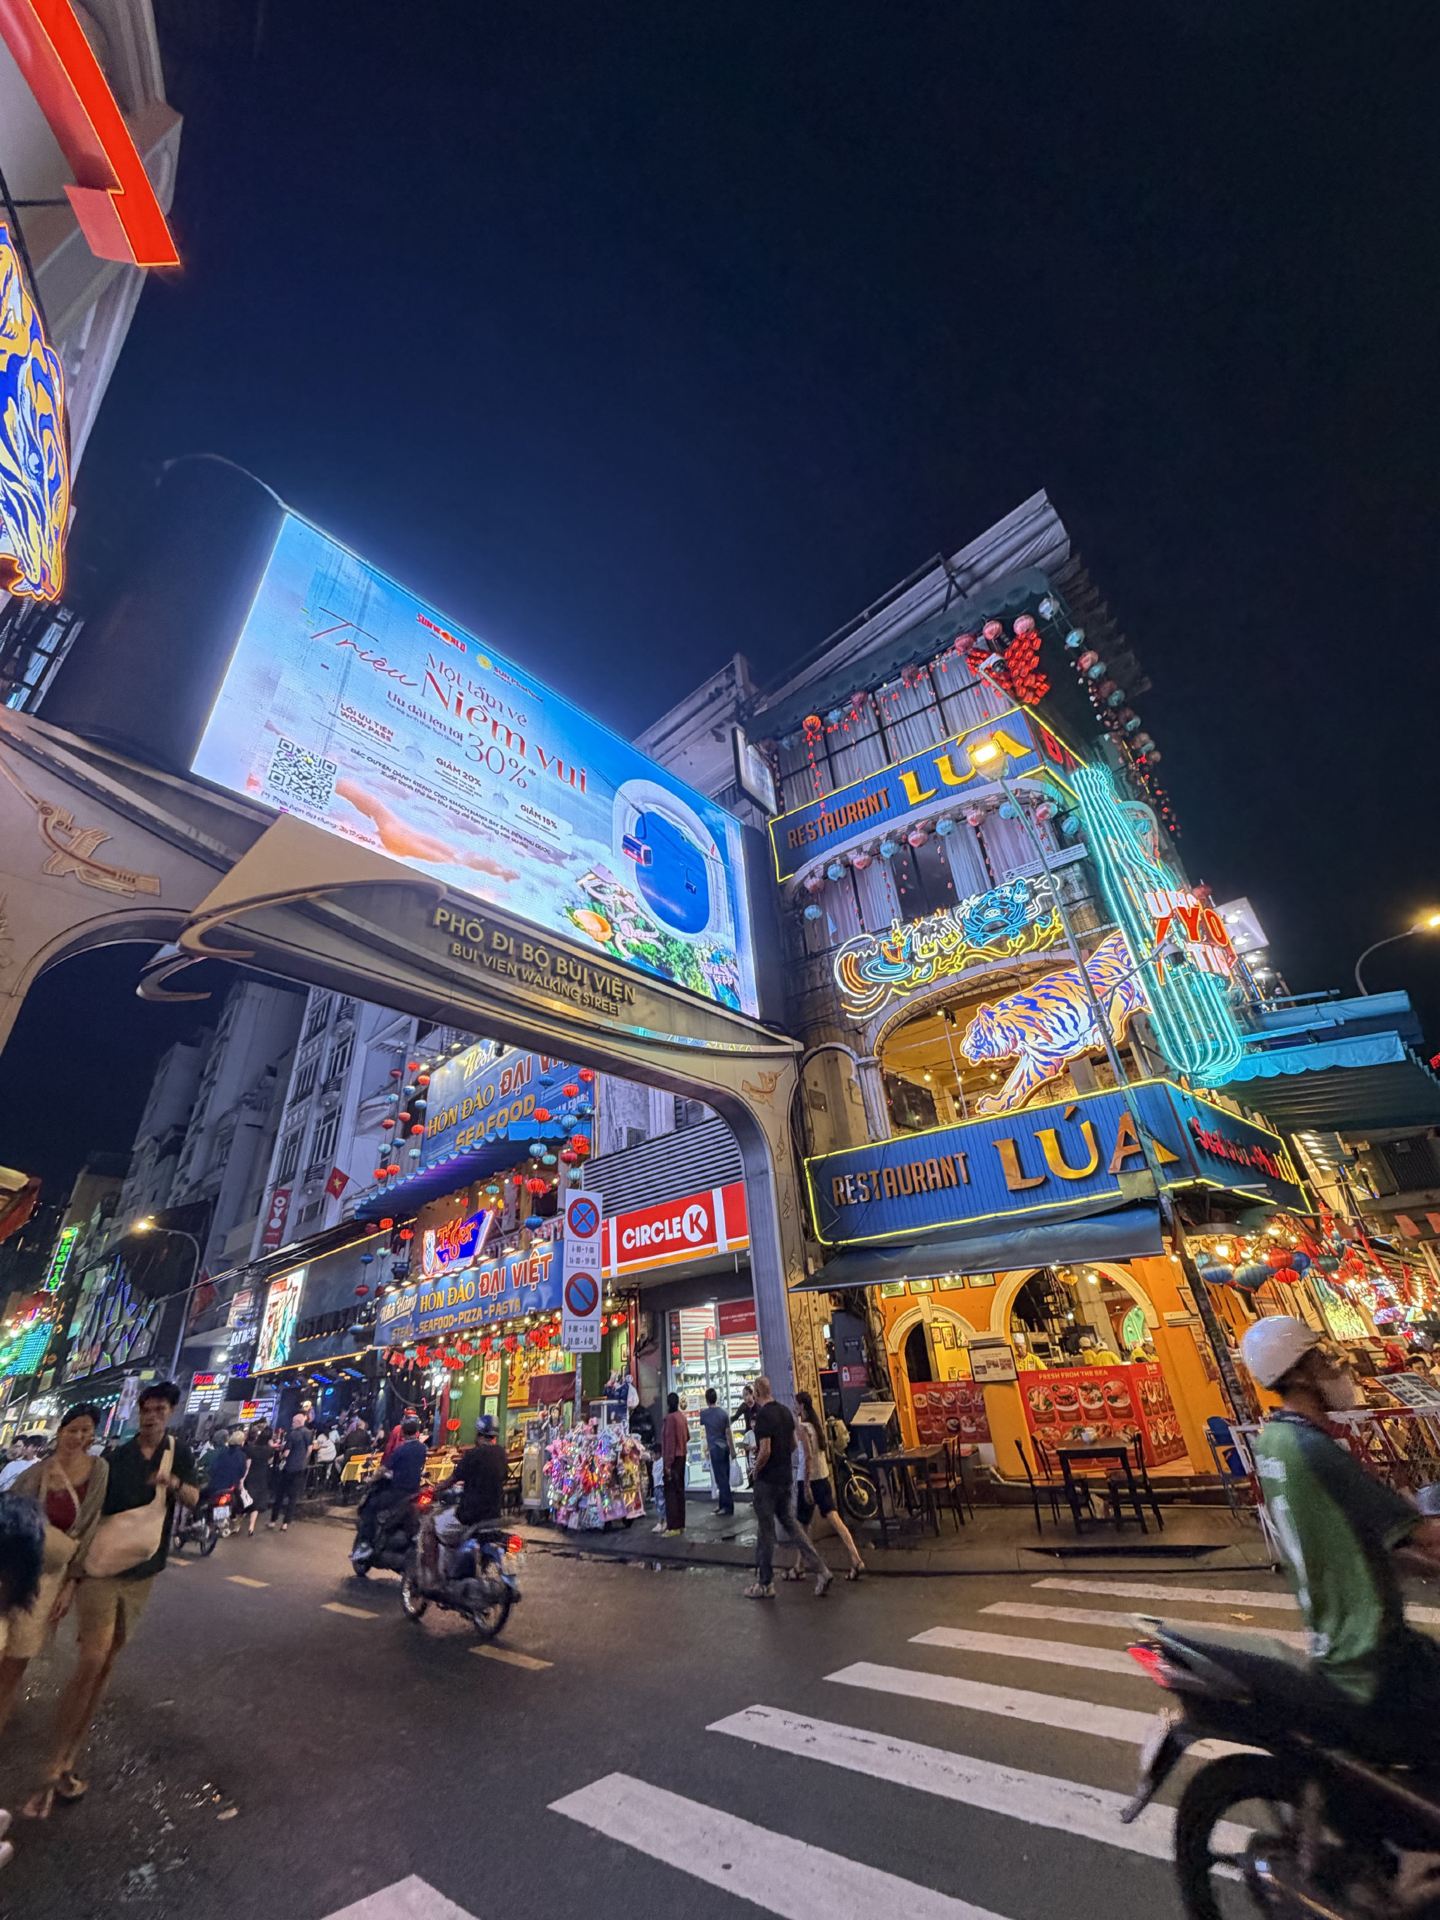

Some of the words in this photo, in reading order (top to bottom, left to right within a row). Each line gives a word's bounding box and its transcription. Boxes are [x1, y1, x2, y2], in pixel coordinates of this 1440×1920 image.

[388, 690, 405, 708] Ưu
[426, 652, 463, 687] Một
[467, 680, 504, 713] tấm
[507, 706, 528, 728] vé
[340, 710, 368, 729] WOW
[368, 725, 392, 742] PASS
[421, 669, 526, 759] Niềm
[534, 744, 587, 794] vui
[269, 783, 290, 796] SCAN
[292, 792, 303, 802] TO
[303, 798, 325, 811] BOOK
[435, 757, 462, 777] GIẢM
[462, 770, 483, 788] 20%
[519, 804, 543, 822] GIẢM
[787, 787, 891, 849] RESTAURANT
[433, 906, 485, 944] PHỐ
[491, 930, 515, 956] ĐI
[521, 943, 550, 971] BỘ
[555, 954, 590, 985] BÙI
[593, 971, 637, 1004] VIỆN
[452, 941, 479, 963] BUI
[481, 955, 518, 977] VIEN
[519, 967, 581, 1001] WALKING
[582, 991, 622, 1016] STREET
[427, 1104, 459, 1140] HÒN
[498, 1054, 533, 1099] ĐẠI
[454, 1093, 537, 1152] SEAFOOD
[832, 1151, 969, 1207] RESTAURANT
[991, 1105, 1181, 1192] LÚA
[269, 1196, 287, 1230] OYO
[437, 1216, 477, 1260] Tiger
[621, 1216, 682, 1250] CIRCLE
[685, 1207, 708, 1240] K
[419, 1287, 445, 1314] HÒN
[478, 1269, 506, 1301] ĐẠI
[511, 1248, 554, 1291] VIỆT
[1060, 1370, 1080, 1379] FROM
